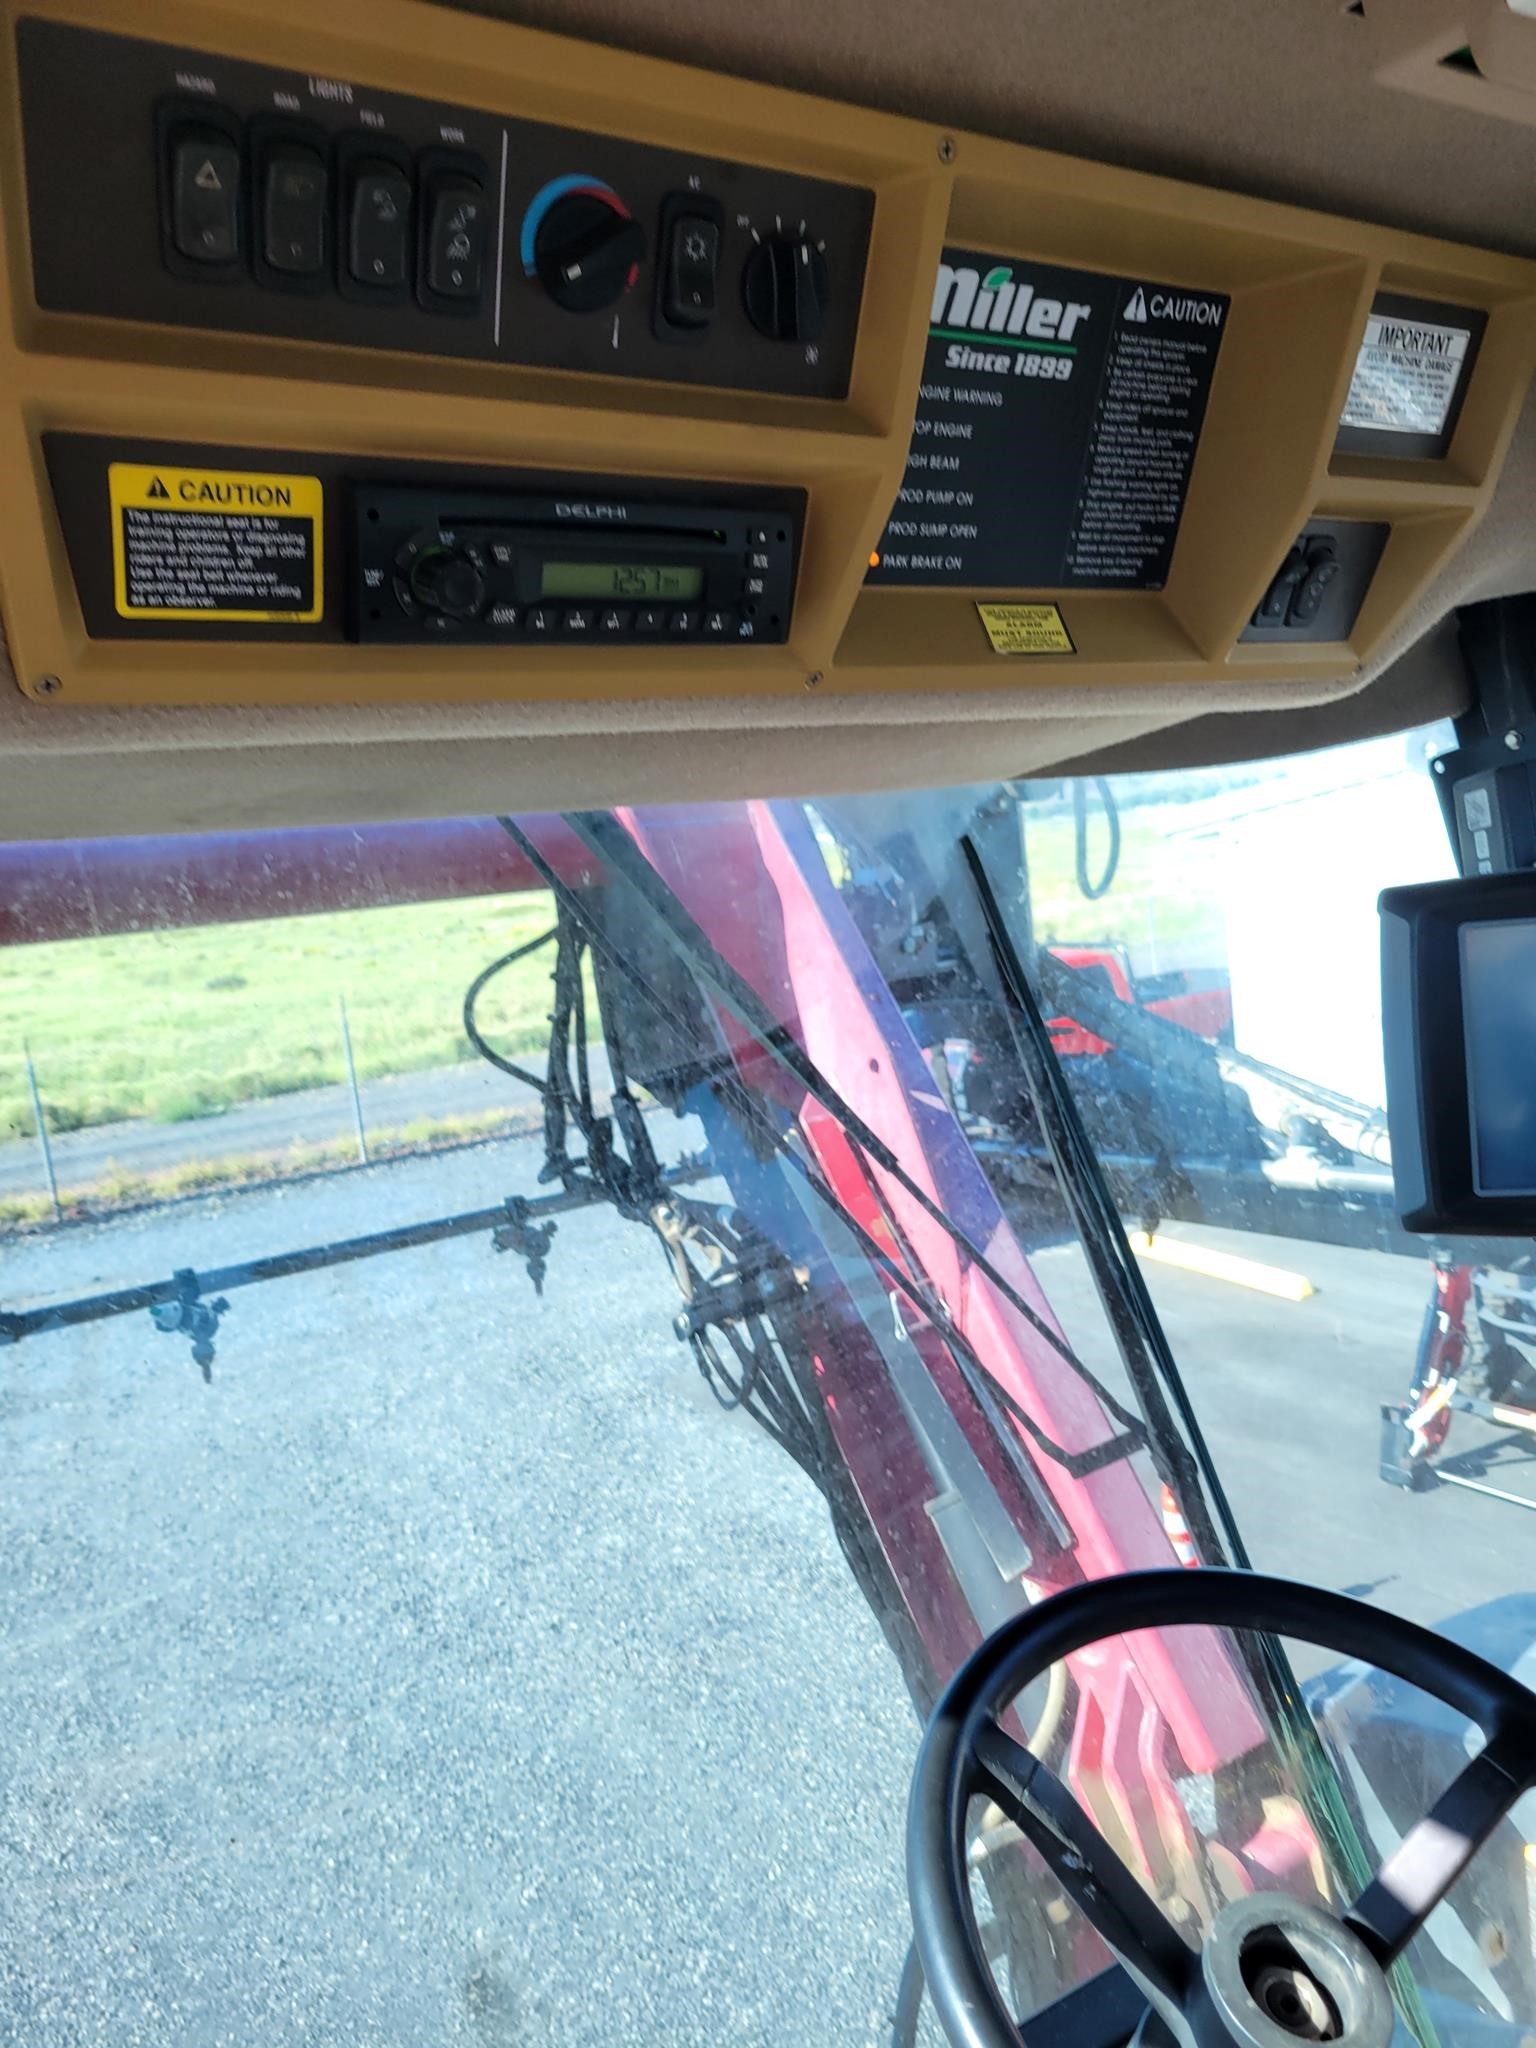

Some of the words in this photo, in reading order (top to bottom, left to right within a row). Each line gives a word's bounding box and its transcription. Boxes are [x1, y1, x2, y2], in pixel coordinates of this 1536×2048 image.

[308, 78, 355, 105] LIGHTS
[1150, 293, 1223, 327] CAUTION
[1378, 323, 1454, 357] IMPORTANT
[945, 345, 1011, 374] Since
[919, 384, 951, 402] NGINE
[953, 386, 1003, 407] WARNING
[934, 421, 974, 439] ENGINE
[930, 454, 960, 472] BEAM
[178, 479, 292, 507] CAUTION
[926, 488, 955, 505] PUMP
[956, 491, 974, 507] ON
[554, 502, 628, 520] DELPHI
[888, 520, 918, 537] PROD
[949, 523, 978, 539] OPEN
[883, 553, 908, 569] PARK
[911, 554, 943, 570] BRAKE
[944, 555, 963, 570] ON
